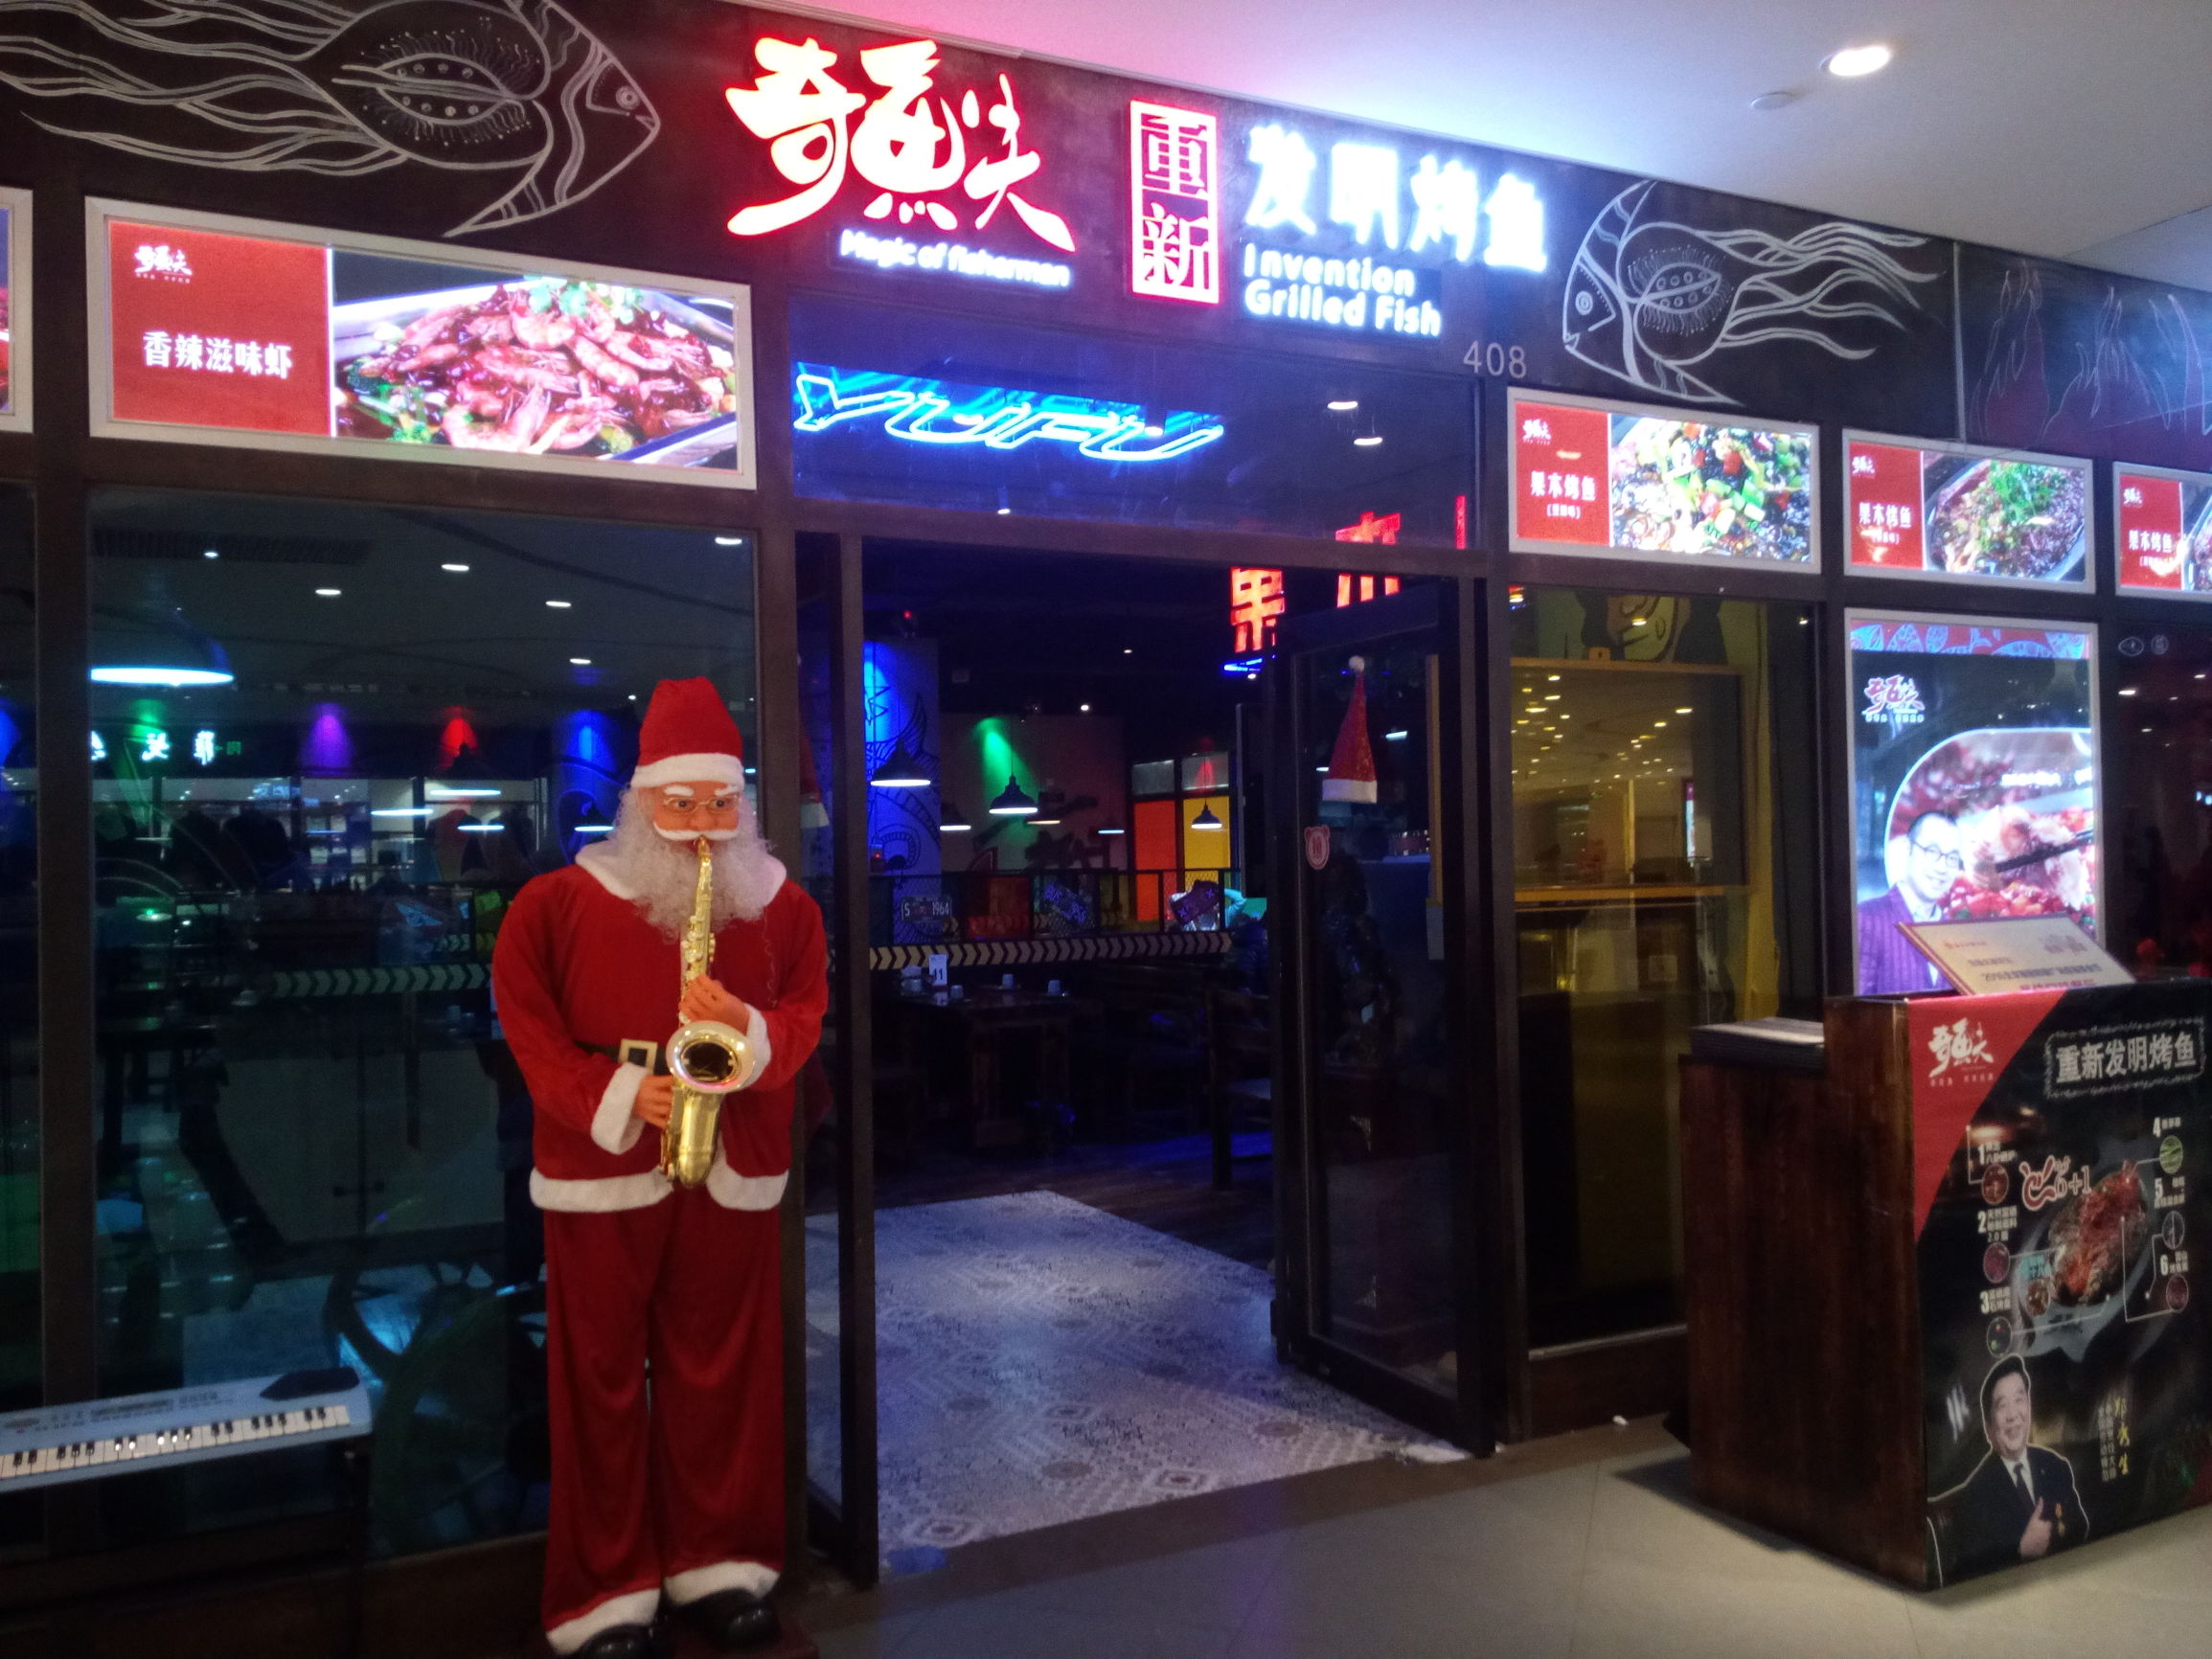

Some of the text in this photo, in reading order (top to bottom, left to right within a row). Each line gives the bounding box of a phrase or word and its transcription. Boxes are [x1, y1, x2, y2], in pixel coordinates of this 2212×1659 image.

[1140, 114, 1209, 289] 重新
[1244, 123, 1548, 272] 发明烤鱼
[840, 229, 917, 267] Magic
[918, 241, 947, 269] of
[1244, 242, 1415, 297] Invention
[1244, 283, 1442, 337] Grilled Fish
[143, 330, 292, 379] 香辣滋味虾
[1462, 339, 1528, 379] 408
[1531, 470, 1596, 502] 果木烤鱼
[1859, 502, 1912, 528] 果木烤鱼
[2129, 530, 2172, 553] 果木烤鱼
[2056, 1031, 2197, 1083] 重新发明烤鱼
